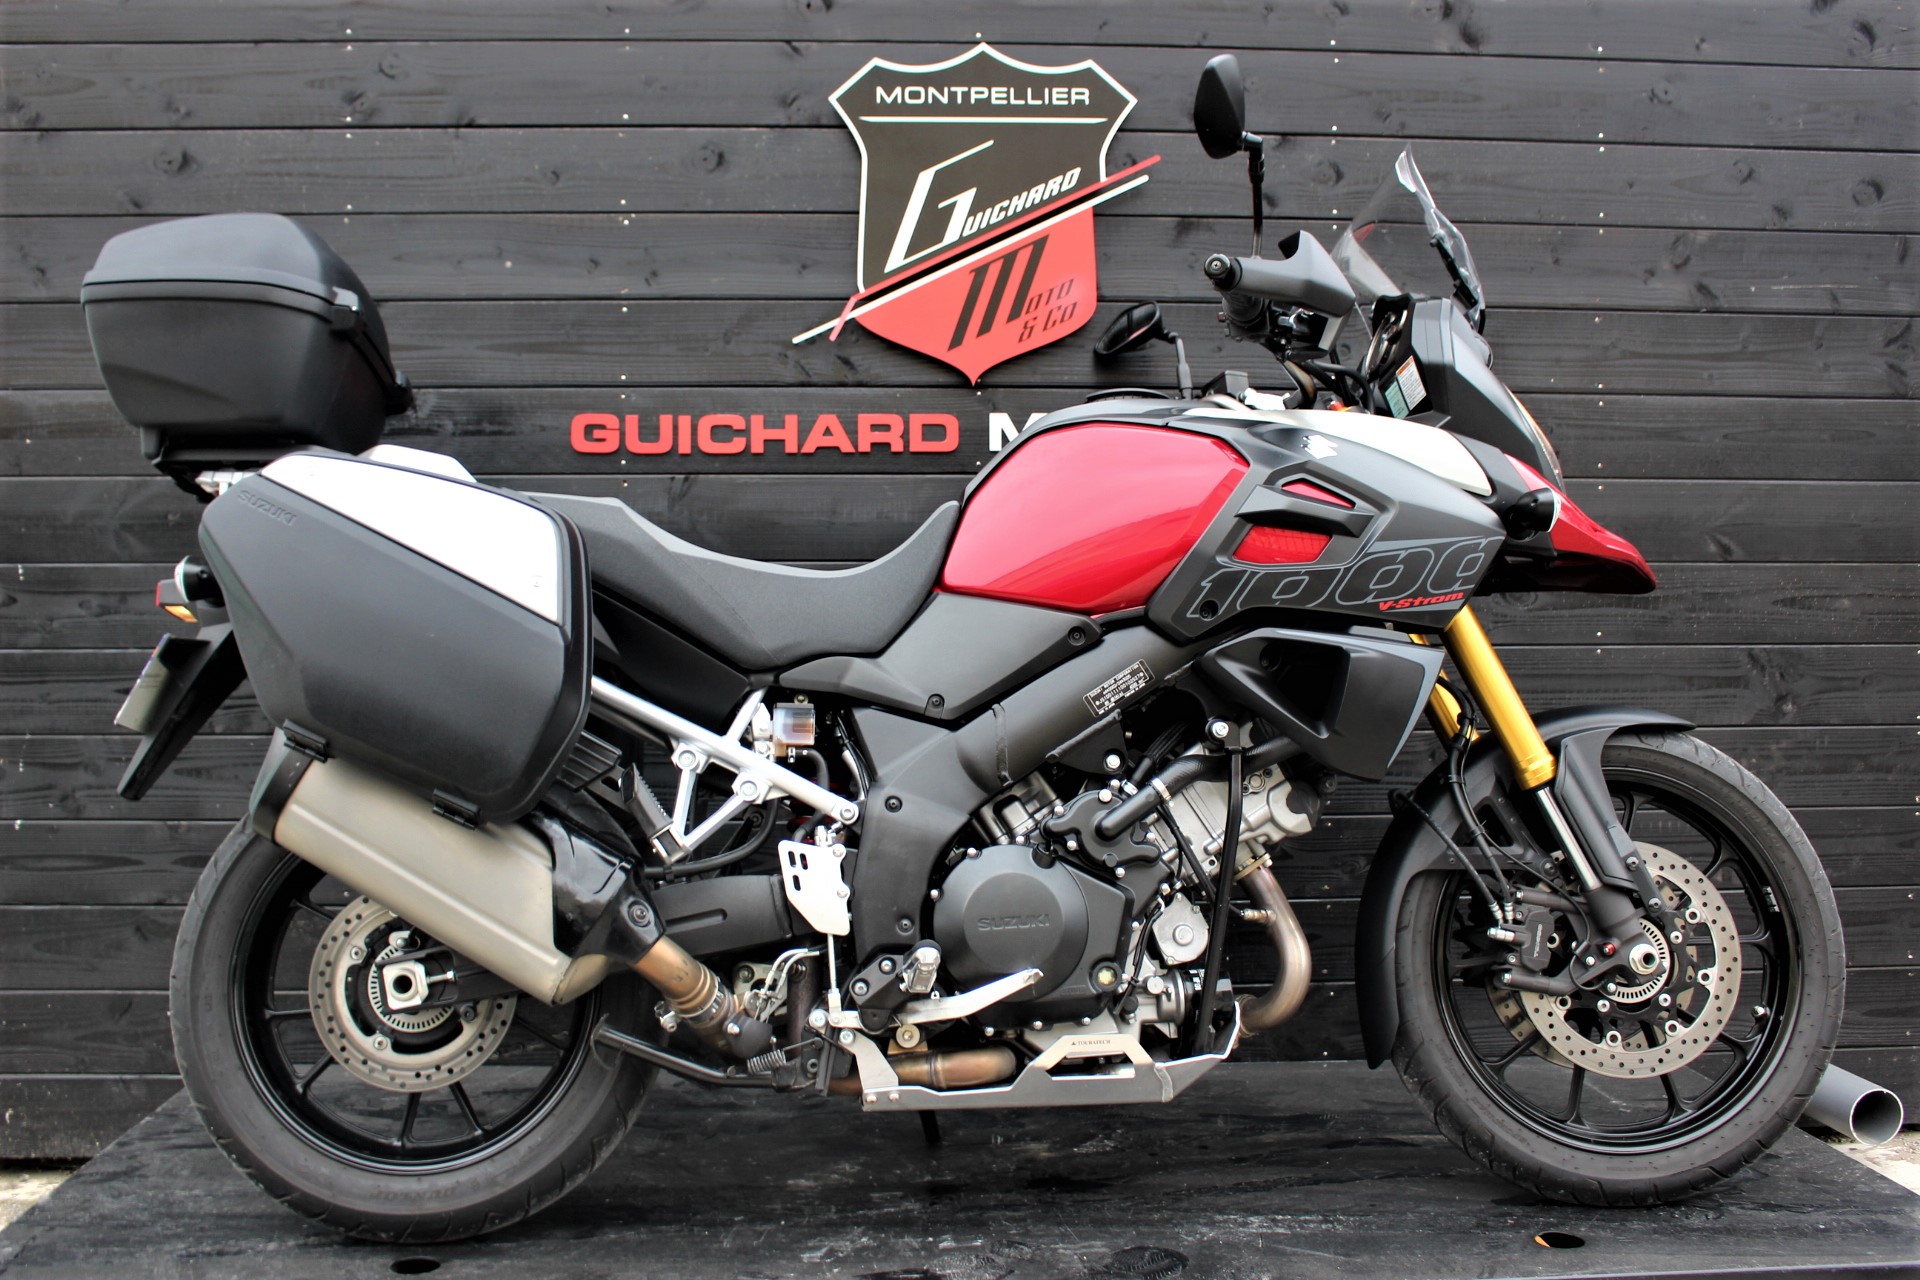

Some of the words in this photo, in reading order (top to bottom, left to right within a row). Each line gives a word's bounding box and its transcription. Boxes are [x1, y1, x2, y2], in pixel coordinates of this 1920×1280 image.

[875, 86, 1090, 106] MONTPELLIER
[884, 139, 1082, 274] GUICHARD
[569, 412, 960, 455] GUICHARD
[238, 489, 297, 526] SUZUKI
[1186, 535, 1507, 619] 1000
[1379, 591, 1465, 612] V-Strom
[977, 914, 1050, 931] SUZUKI
